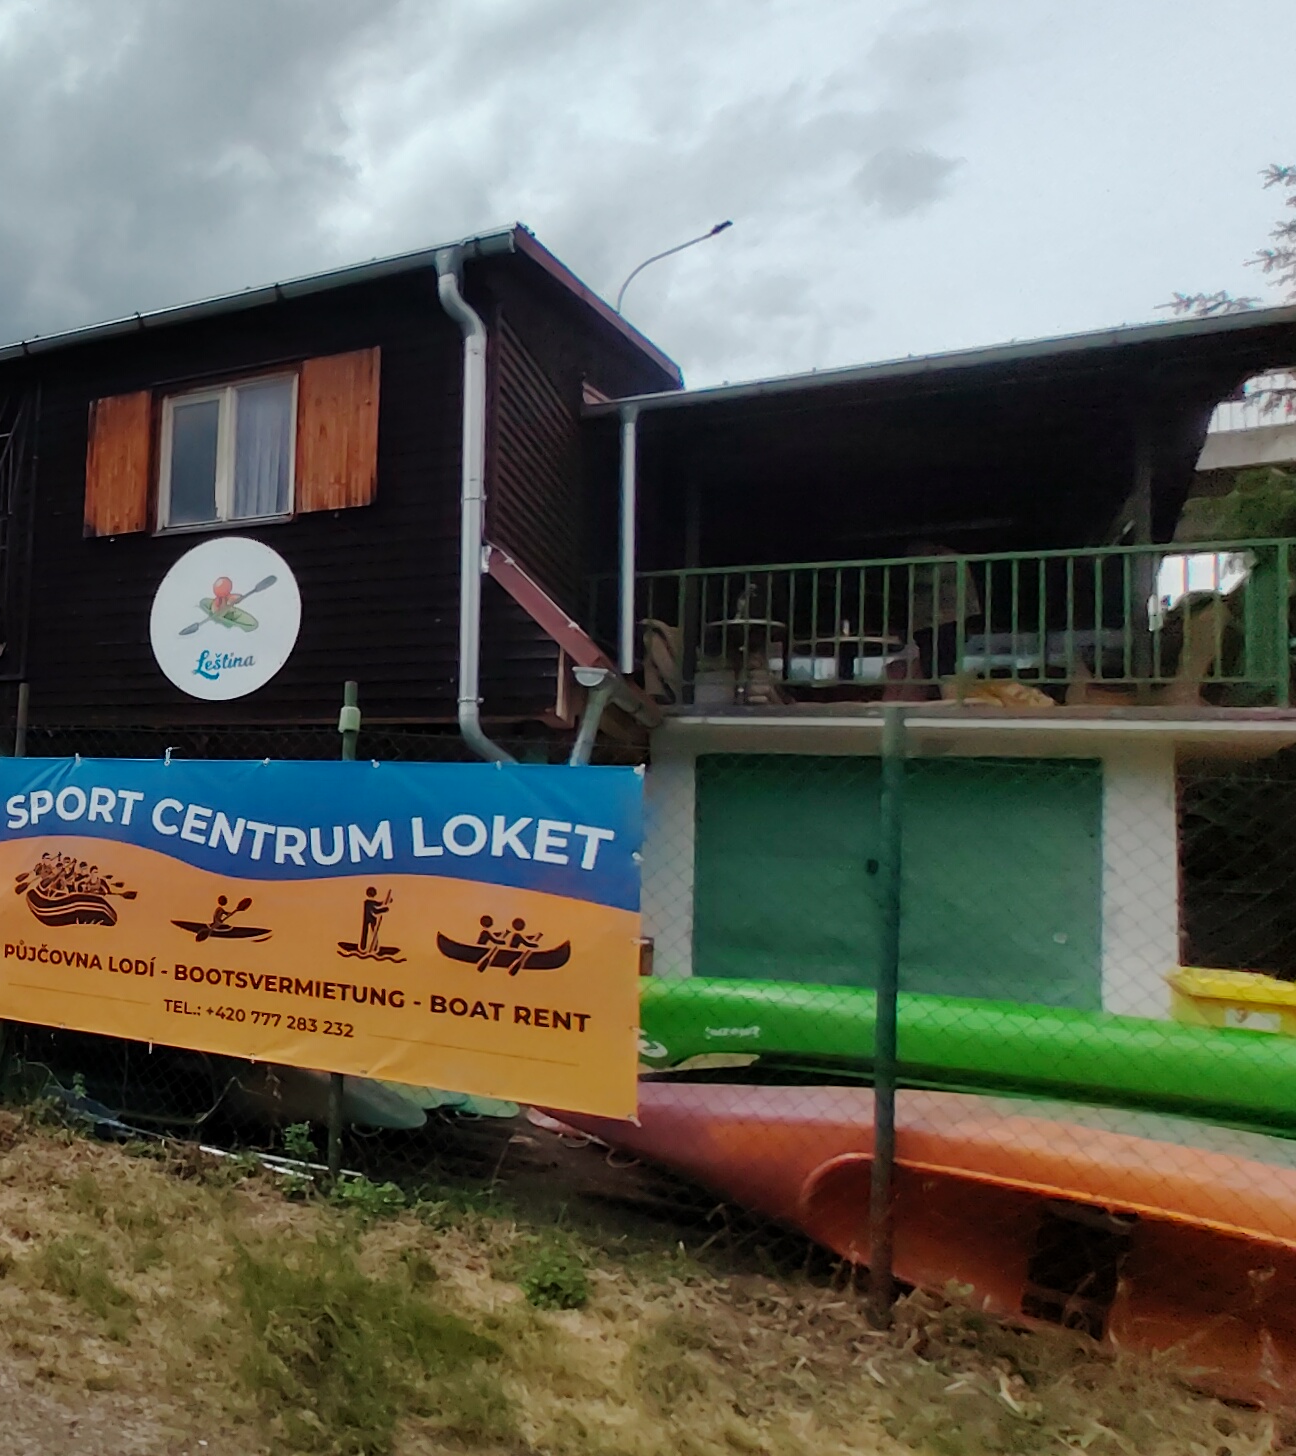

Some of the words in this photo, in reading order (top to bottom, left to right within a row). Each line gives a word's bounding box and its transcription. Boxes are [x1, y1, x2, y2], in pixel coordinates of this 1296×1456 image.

[193, 649, 255, 680] Leština
[6, 785, 145, 829] SPORT
[152, 797, 394, 867] CENTRUM
[411, 813, 615, 871] LOKET
[4, 939, 102, 970] PŮJČOVNA
[108, 956, 156, 977] LODÍ
[174, 964, 405, 1008] BOOTSVERMIETUNG
[430, 994, 505, 1022] BOAT
[512, 1005, 592, 1033] RENT
[164, 999, 201, 1016] TEL.:
[206, 1006, 246, 1023] +420
[251, 1010, 282, 1027] 777
[287, 1015, 318, 1033] 283
[323, 1020, 355, 1038] 232
